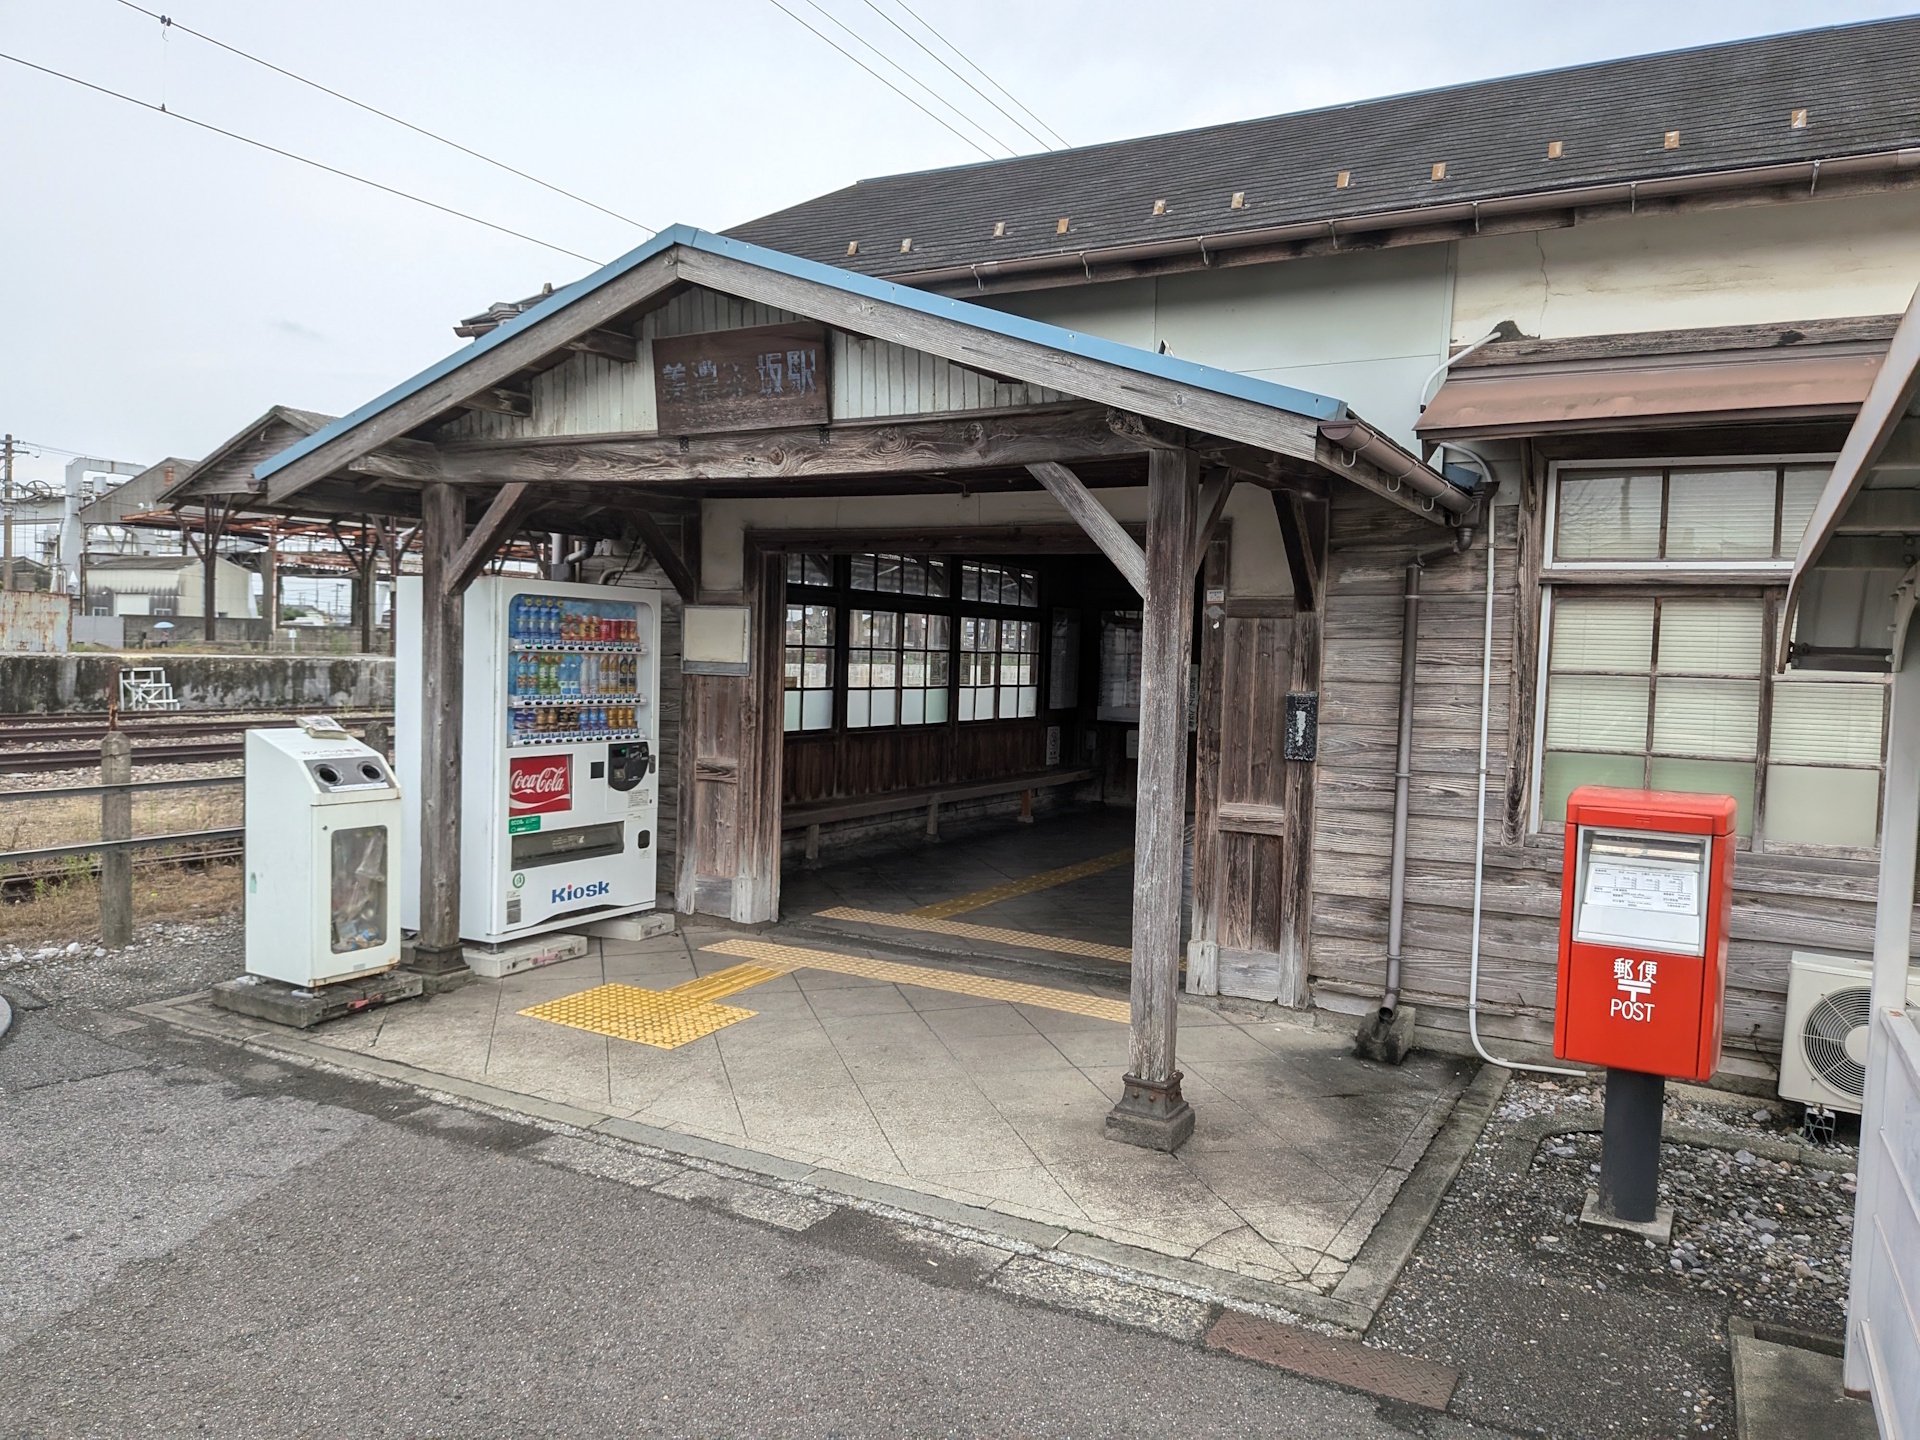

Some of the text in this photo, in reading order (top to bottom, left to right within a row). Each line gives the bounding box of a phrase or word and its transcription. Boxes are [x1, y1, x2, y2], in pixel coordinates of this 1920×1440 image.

[662, 349, 816, 400] 美濃坂駅
[510, 766, 567, 795] Coca-Cola
[551, 880, 610, 904] Kiosk
[1613, 957, 1658, 984] 郵便
[1610, 998, 1656, 1022] POST
